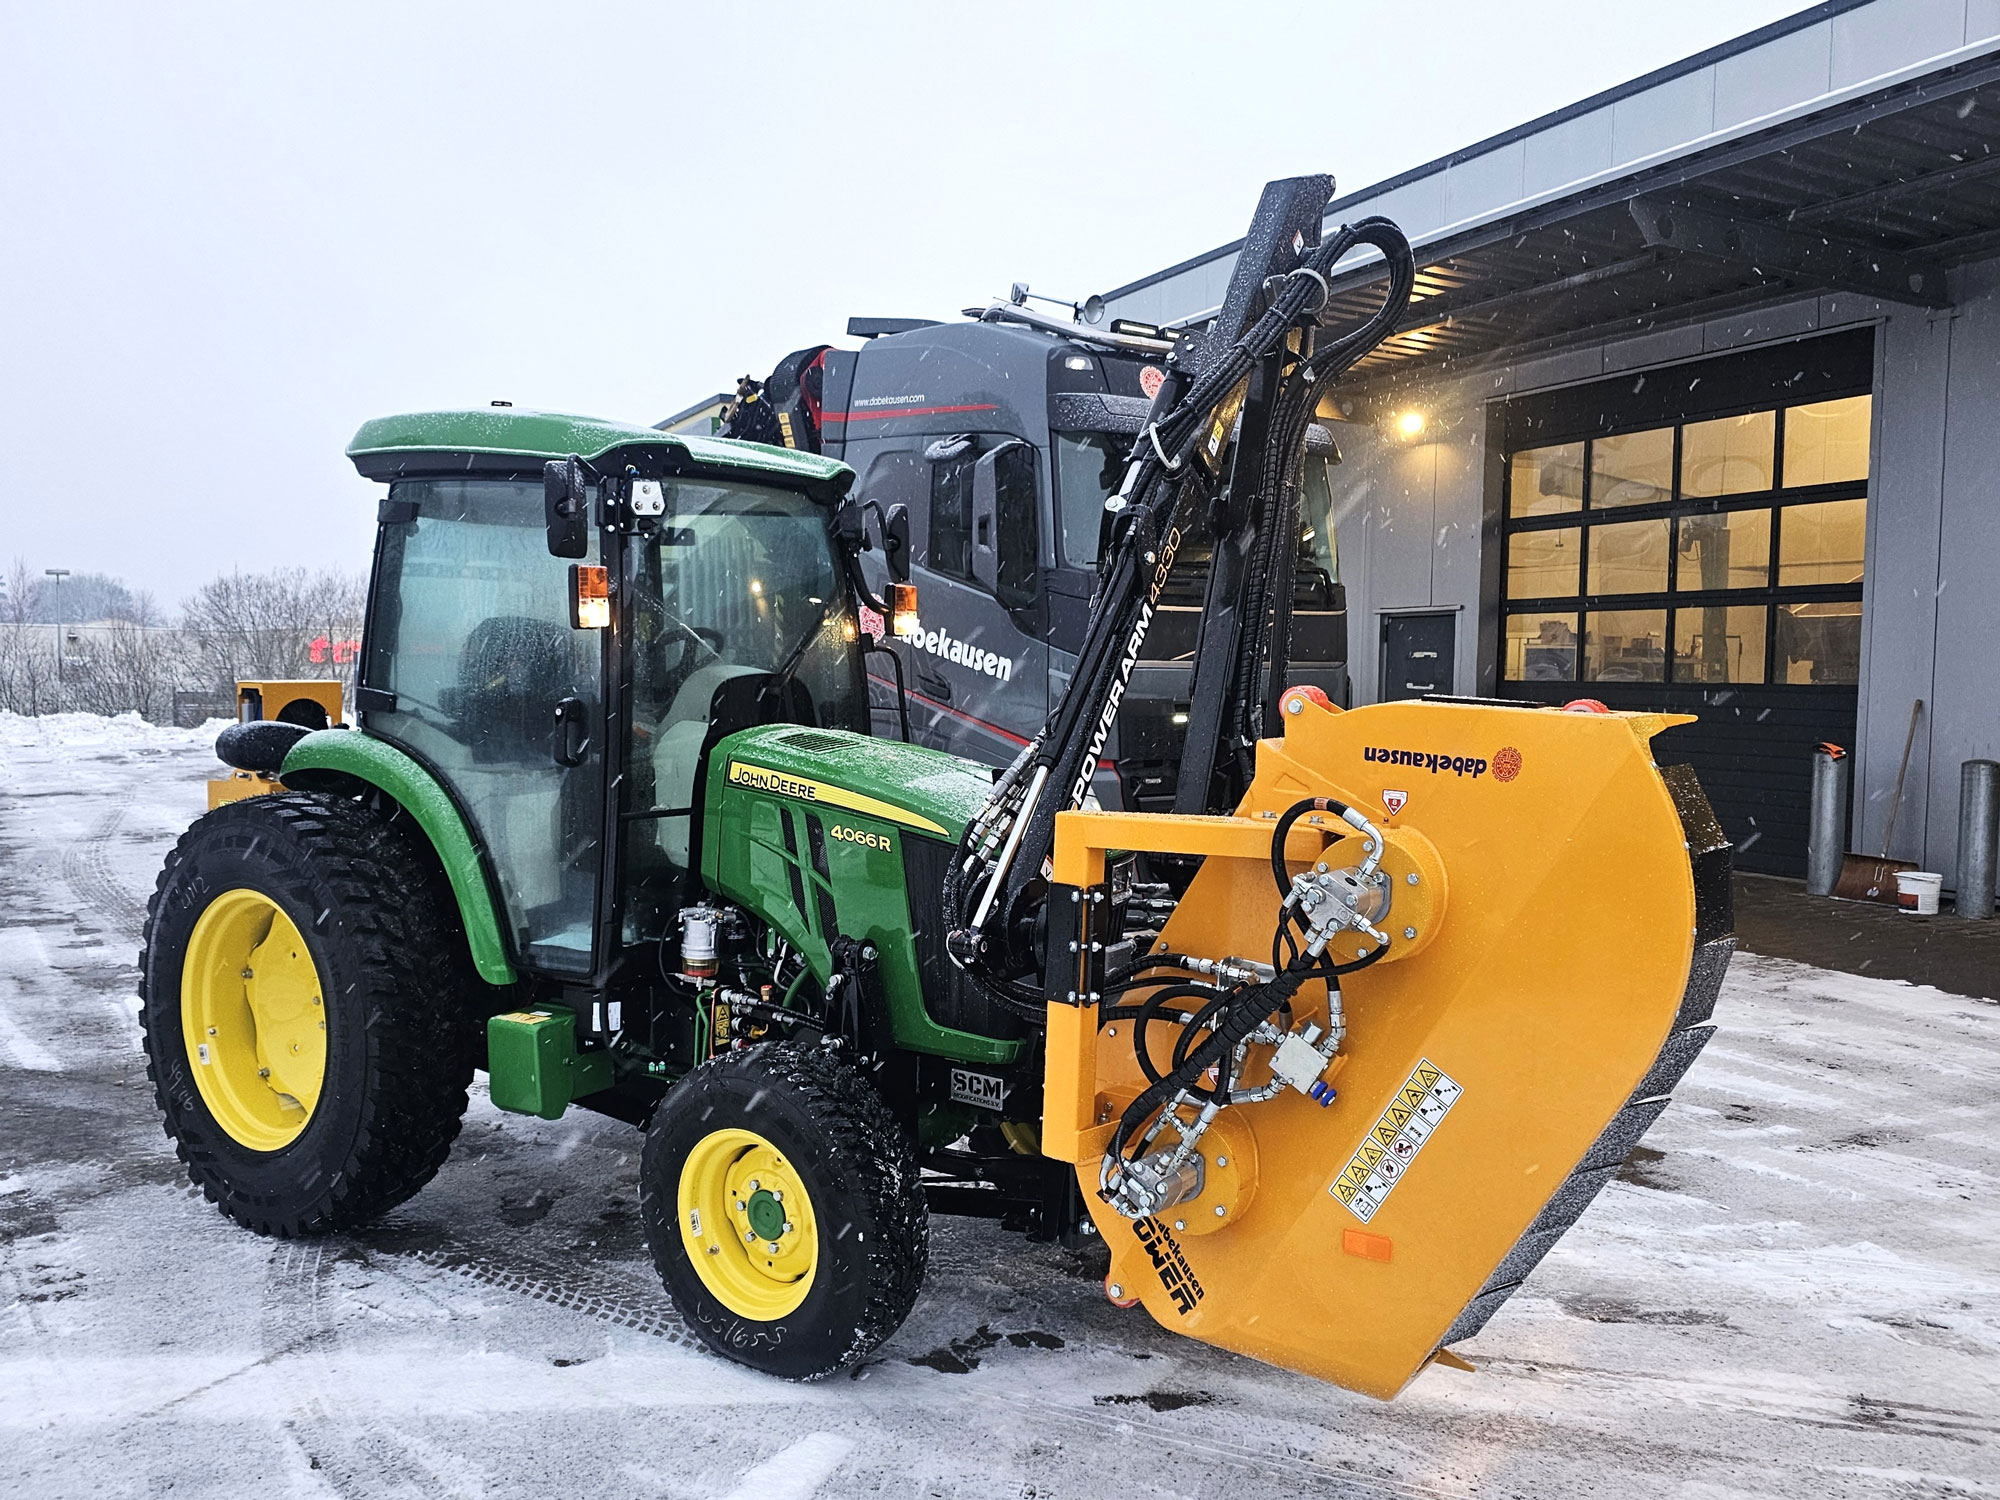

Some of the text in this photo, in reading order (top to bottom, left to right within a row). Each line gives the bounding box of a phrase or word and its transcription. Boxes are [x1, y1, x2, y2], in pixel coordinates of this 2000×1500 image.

[854, 394, 925, 407] www.dabekausen.com
[1150, 527, 1182, 605] 4330
[1364, 746, 1487, 779] dabekausen
[734, 767, 816, 799] JOHN DEERE
[953, 1071, 1001, 1101] SCM
[1152, 1215, 1205, 1301] abekausen
